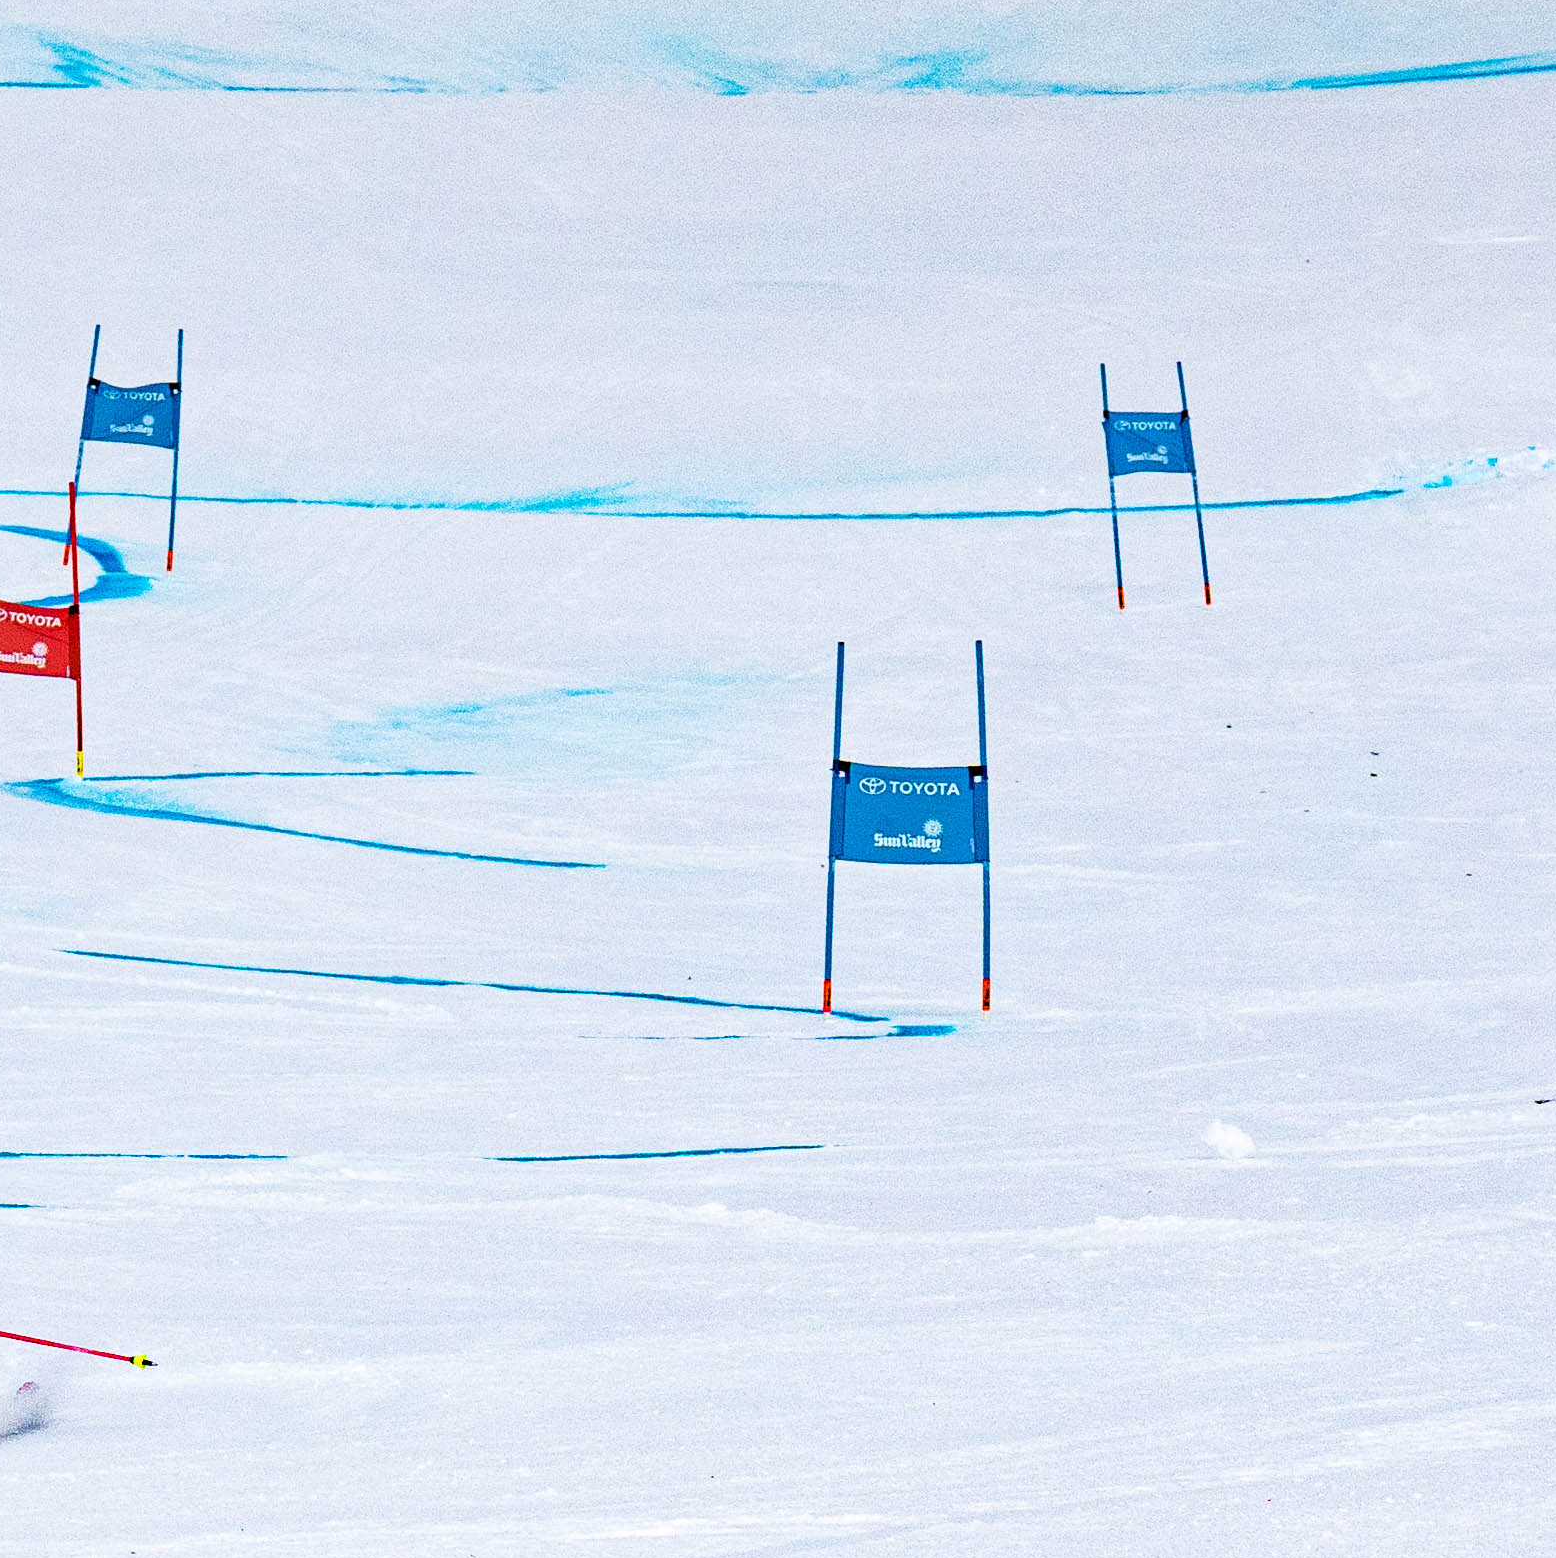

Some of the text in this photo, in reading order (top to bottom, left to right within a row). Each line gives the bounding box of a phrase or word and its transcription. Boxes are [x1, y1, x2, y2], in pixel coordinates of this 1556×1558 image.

[1132, 421, 1177, 431] TOYOTA
[9, 610, 62, 629] TOYOTA
[889, 780, 961, 796] TOYOTA
